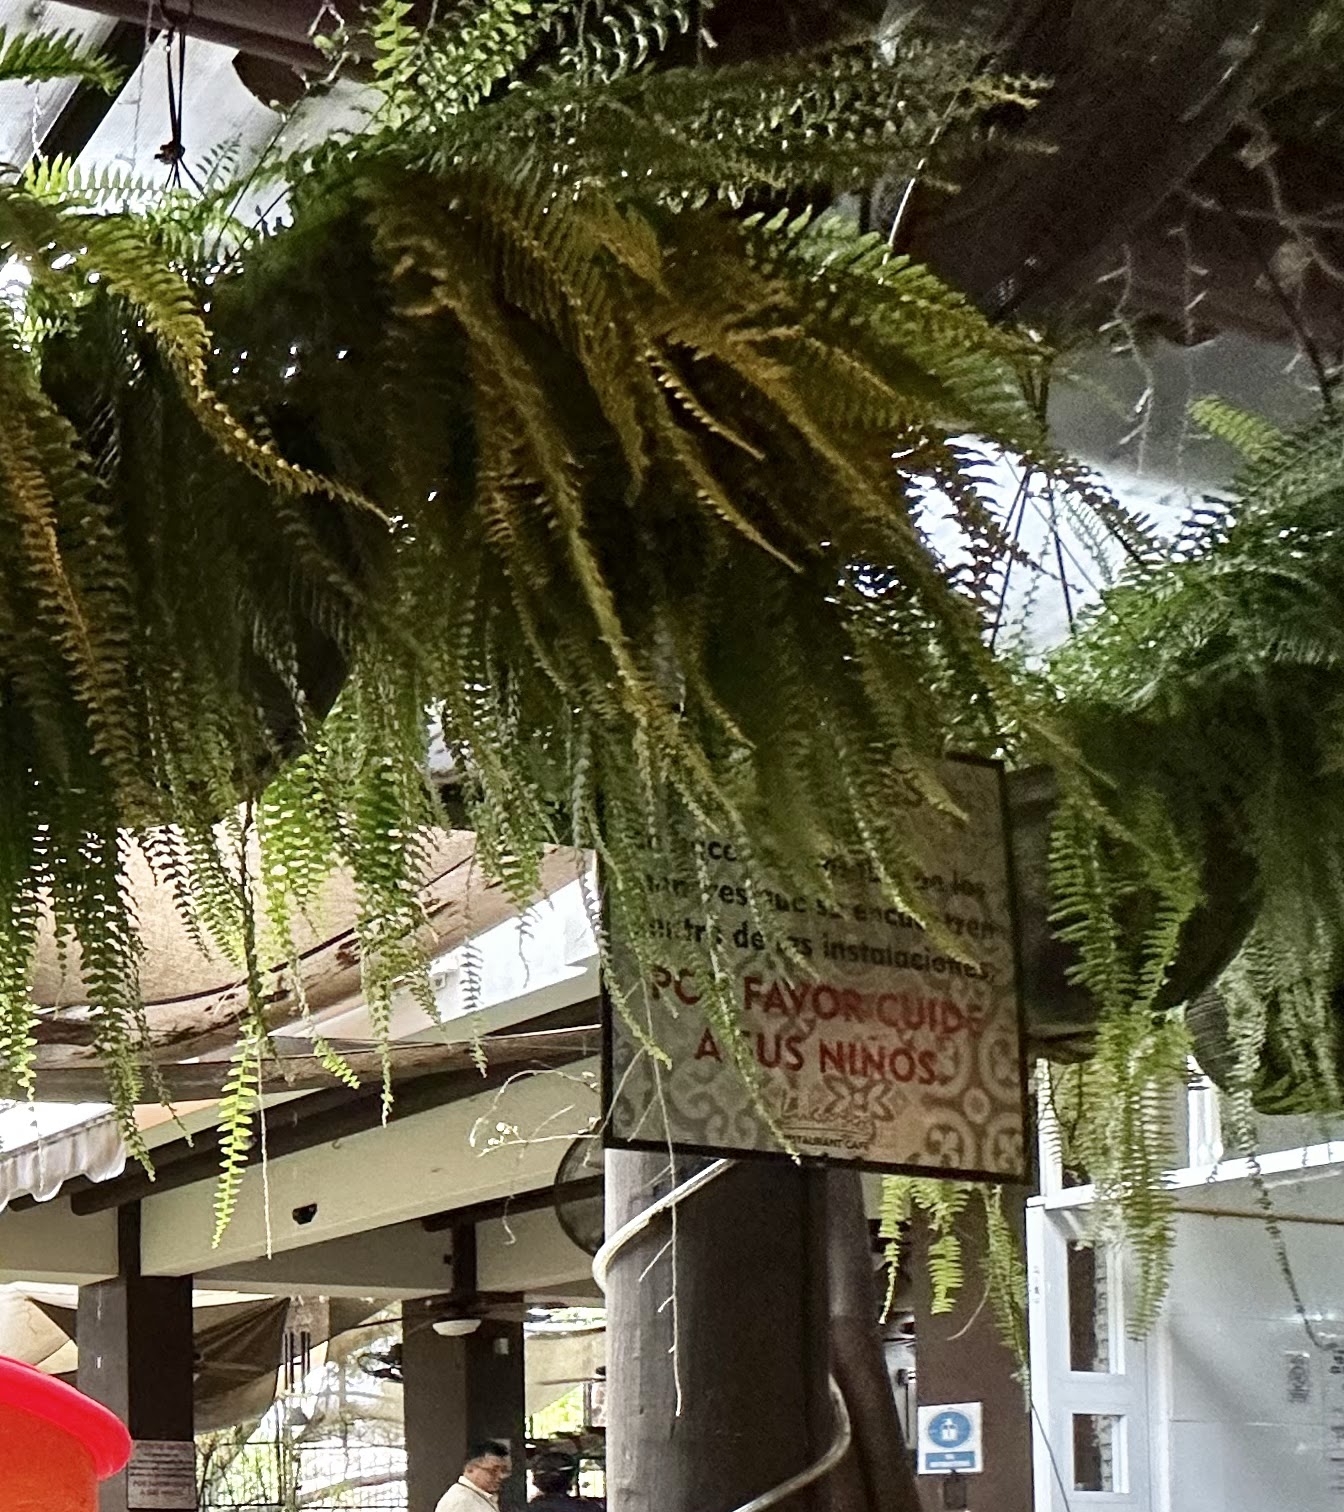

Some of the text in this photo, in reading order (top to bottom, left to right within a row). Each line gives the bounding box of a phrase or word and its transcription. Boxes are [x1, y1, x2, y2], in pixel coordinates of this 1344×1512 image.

[733, 921, 765, 950] de
[650, 965, 730, 1006] PO
[743, 975, 867, 1024] FAVOR
[694, 1027, 723, 1063] A
